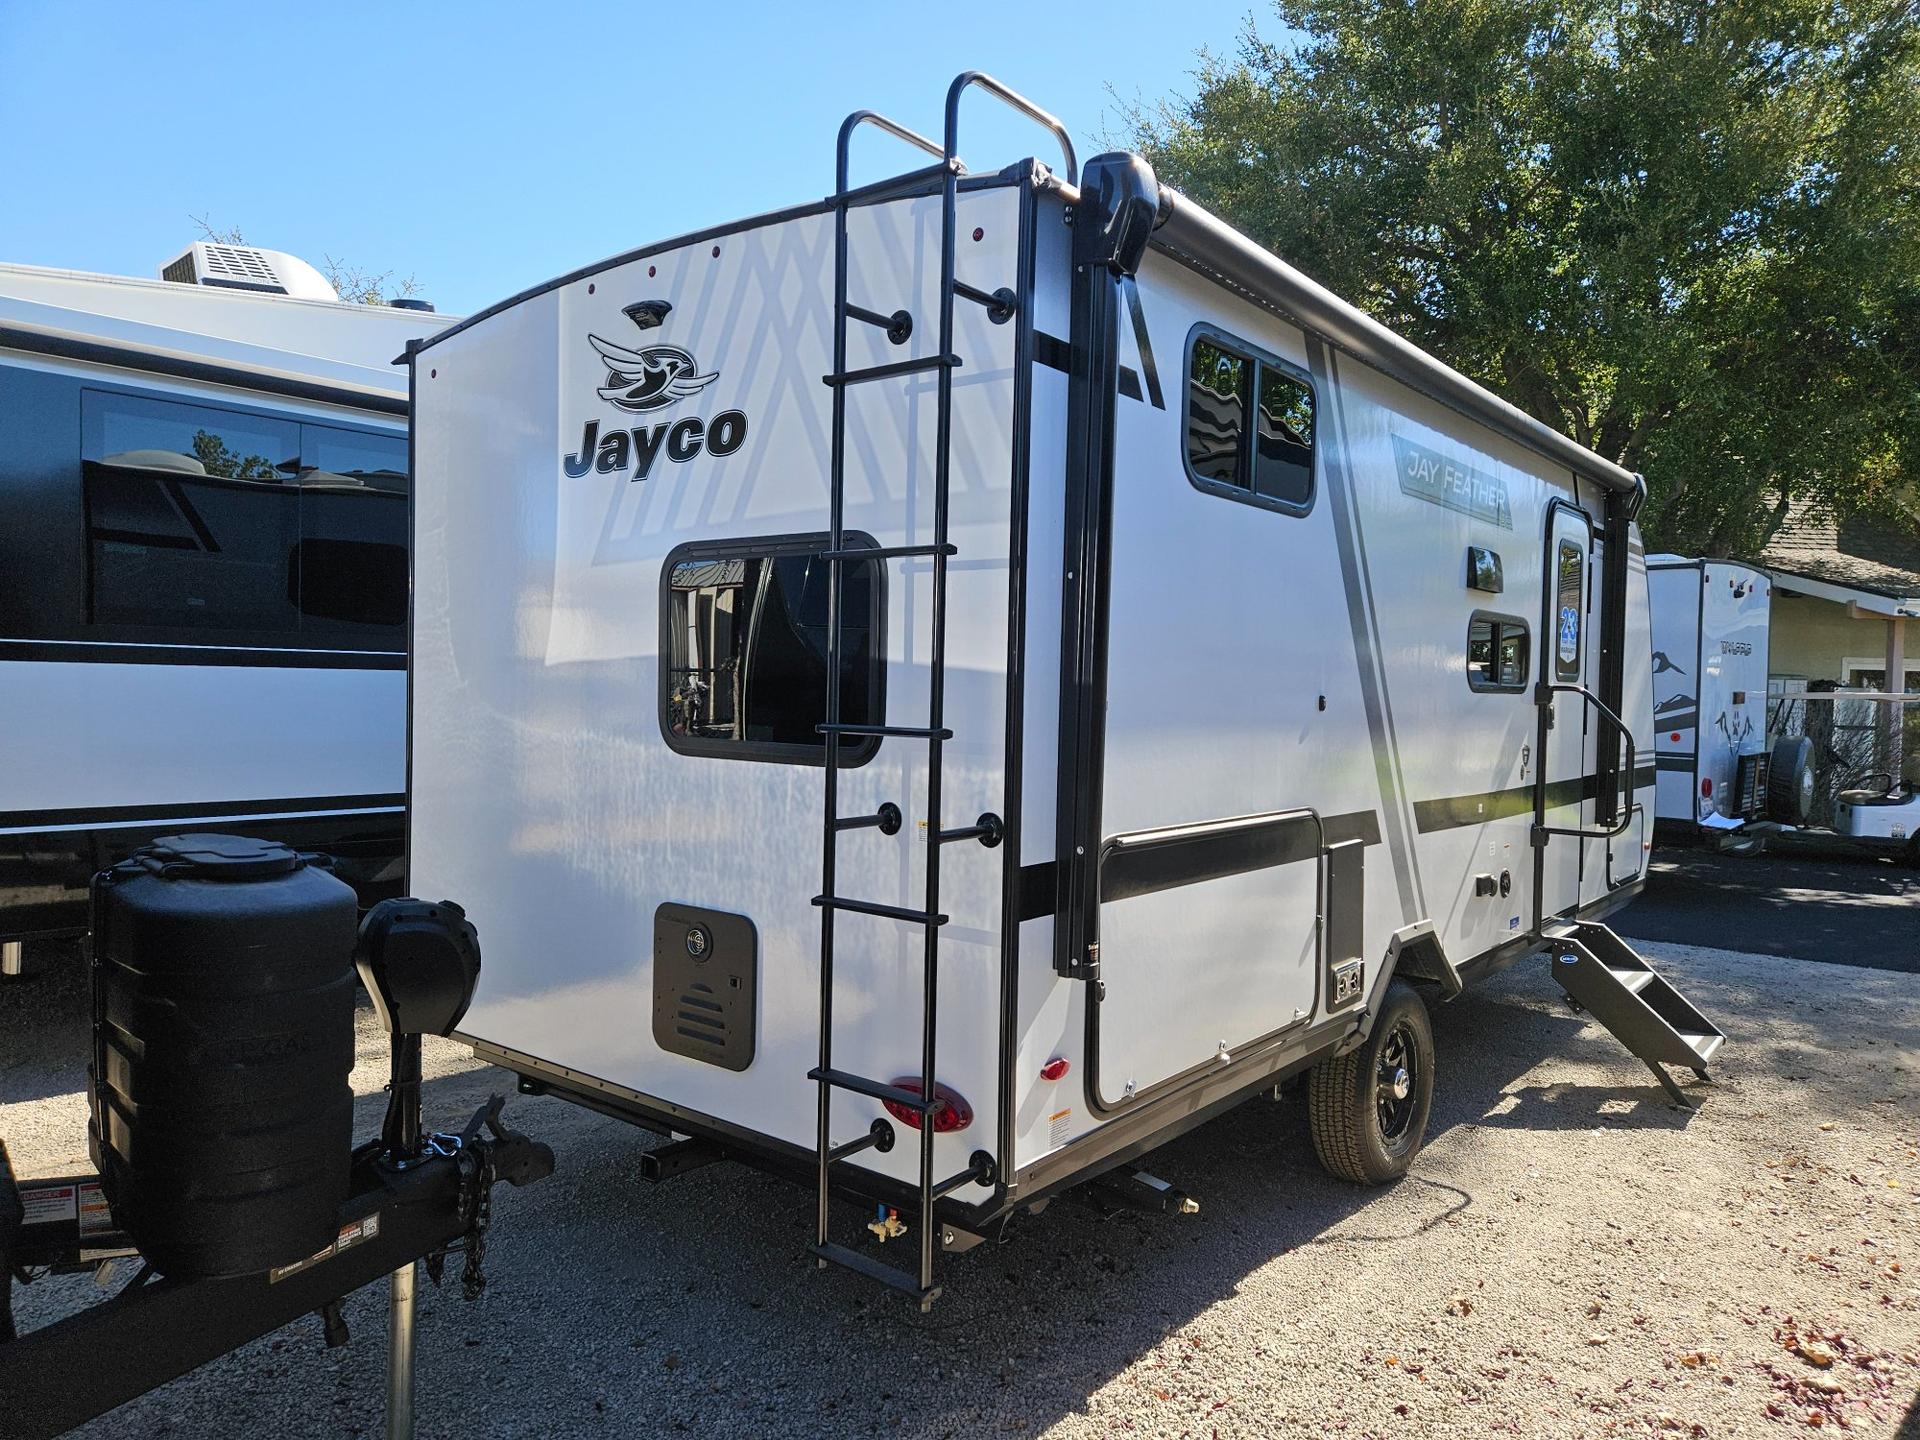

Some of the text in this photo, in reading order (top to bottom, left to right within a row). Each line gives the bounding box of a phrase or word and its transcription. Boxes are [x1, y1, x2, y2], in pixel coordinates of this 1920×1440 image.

[563, 409, 749, 482] Jayco
[1408, 451, 1506, 511] JAY FEATHER
[1561, 606, 1577, 640] 23
